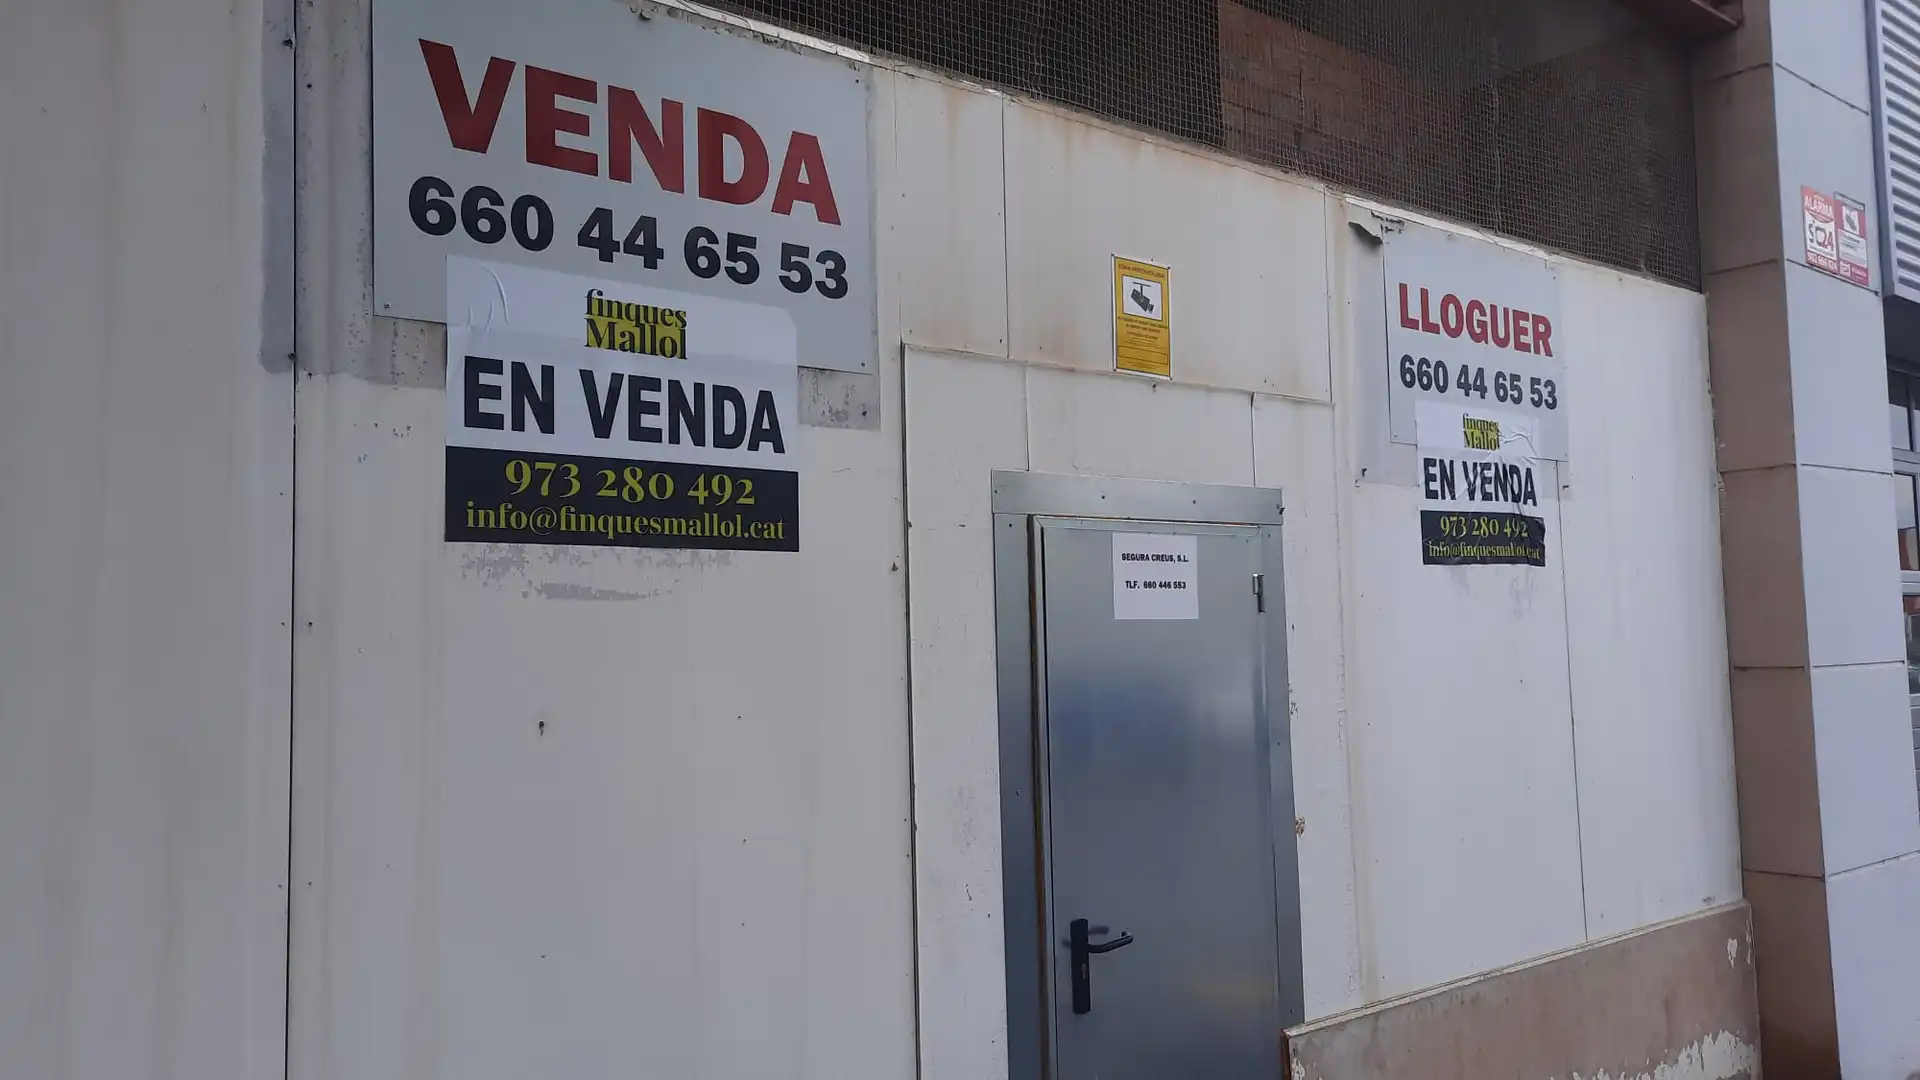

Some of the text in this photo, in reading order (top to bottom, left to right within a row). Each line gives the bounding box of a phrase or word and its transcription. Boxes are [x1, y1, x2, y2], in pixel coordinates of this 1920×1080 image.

[418, 38, 842, 227] VENDA
[408, 176, 849, 300] 660 44 65 53
[585, 289, 688, 330] finques
[1398, 282, 1553, 357] LLOGUER
[584, 318, 688, 360] Mallol
[464, 355, 786, 454] EN VENDA
[1400, 354, 1558, 410] 660 44 65 53
[505, 459, 755, 506] 973 280 492
[1423, 457, 1538, 507] EN VENDA
[466, 501, 786, 541] info@finquesmallol.cat
[1440, 516, 1528, 539] 973 280 492
[1121, 553, 1150, 561] SEGURA
[1151, 553, 1176, 564] CREUS,
[1125, 580, 1187, 590] TLF. 660 446 553
